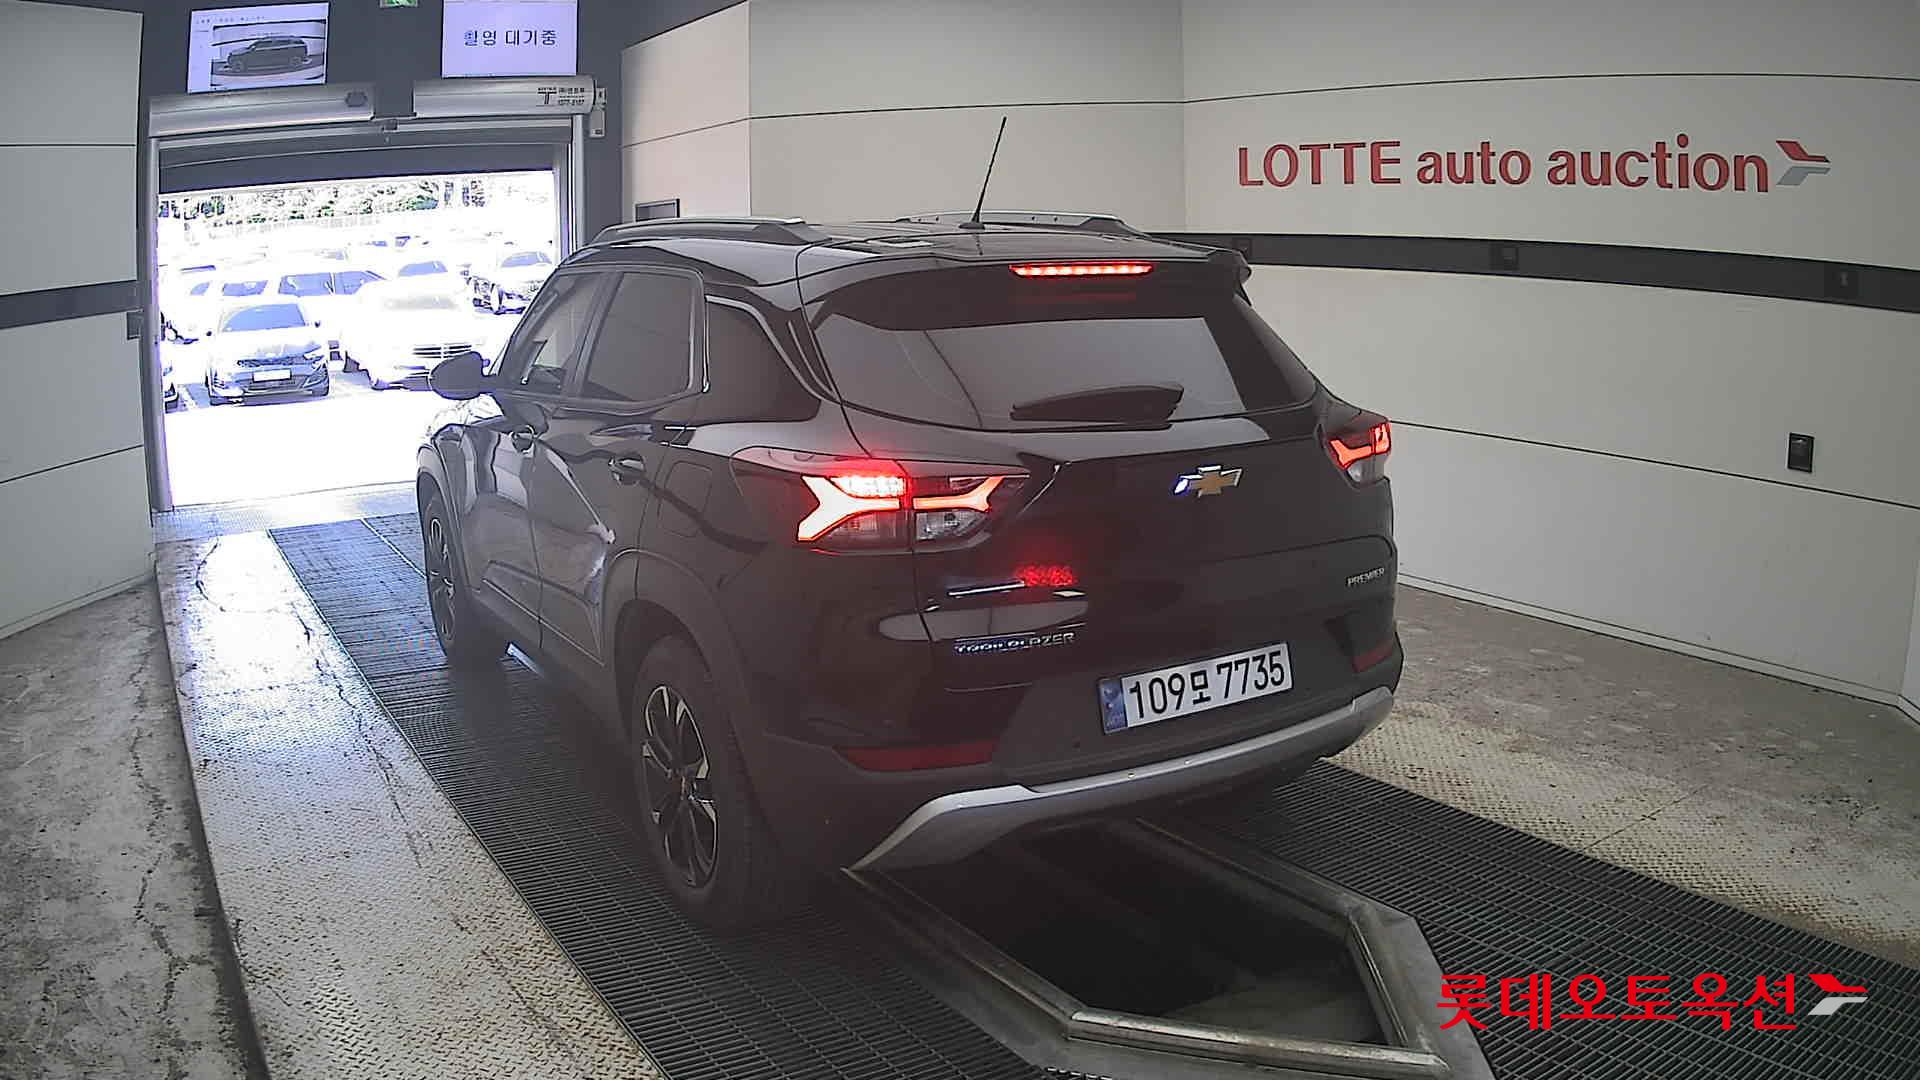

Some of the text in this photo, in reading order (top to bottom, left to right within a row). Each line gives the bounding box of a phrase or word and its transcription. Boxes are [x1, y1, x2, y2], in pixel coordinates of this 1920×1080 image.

[505, 29, 557, 46] 대기중
[1238, 133, 1769, 193] LOTTE auto auction
[1129, 650, 1285, 719] 109모 7735
